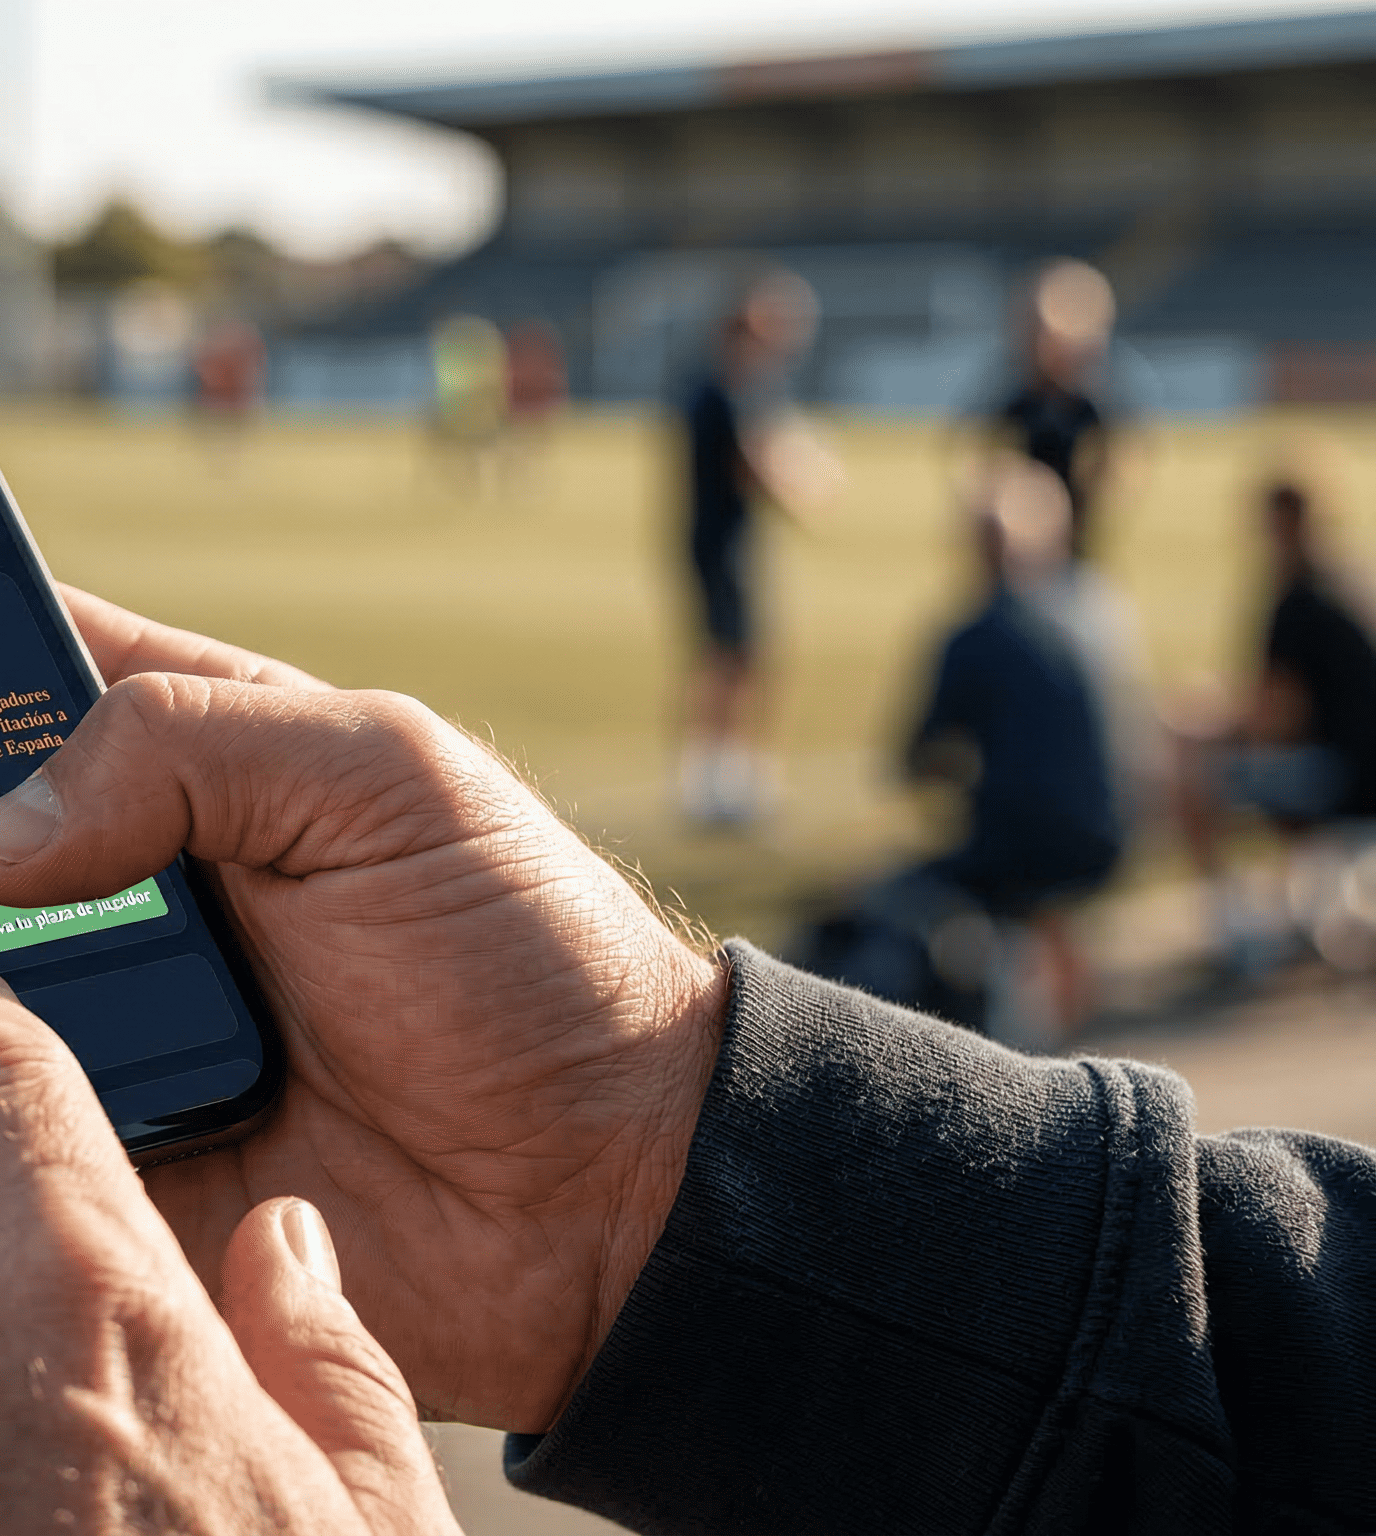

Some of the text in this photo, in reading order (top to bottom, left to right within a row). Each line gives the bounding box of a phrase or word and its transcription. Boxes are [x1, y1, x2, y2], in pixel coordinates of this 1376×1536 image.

[56, 710, 68, 722] a
[3, 732, 65, 756] España
[76, 901, 94, 917] de
